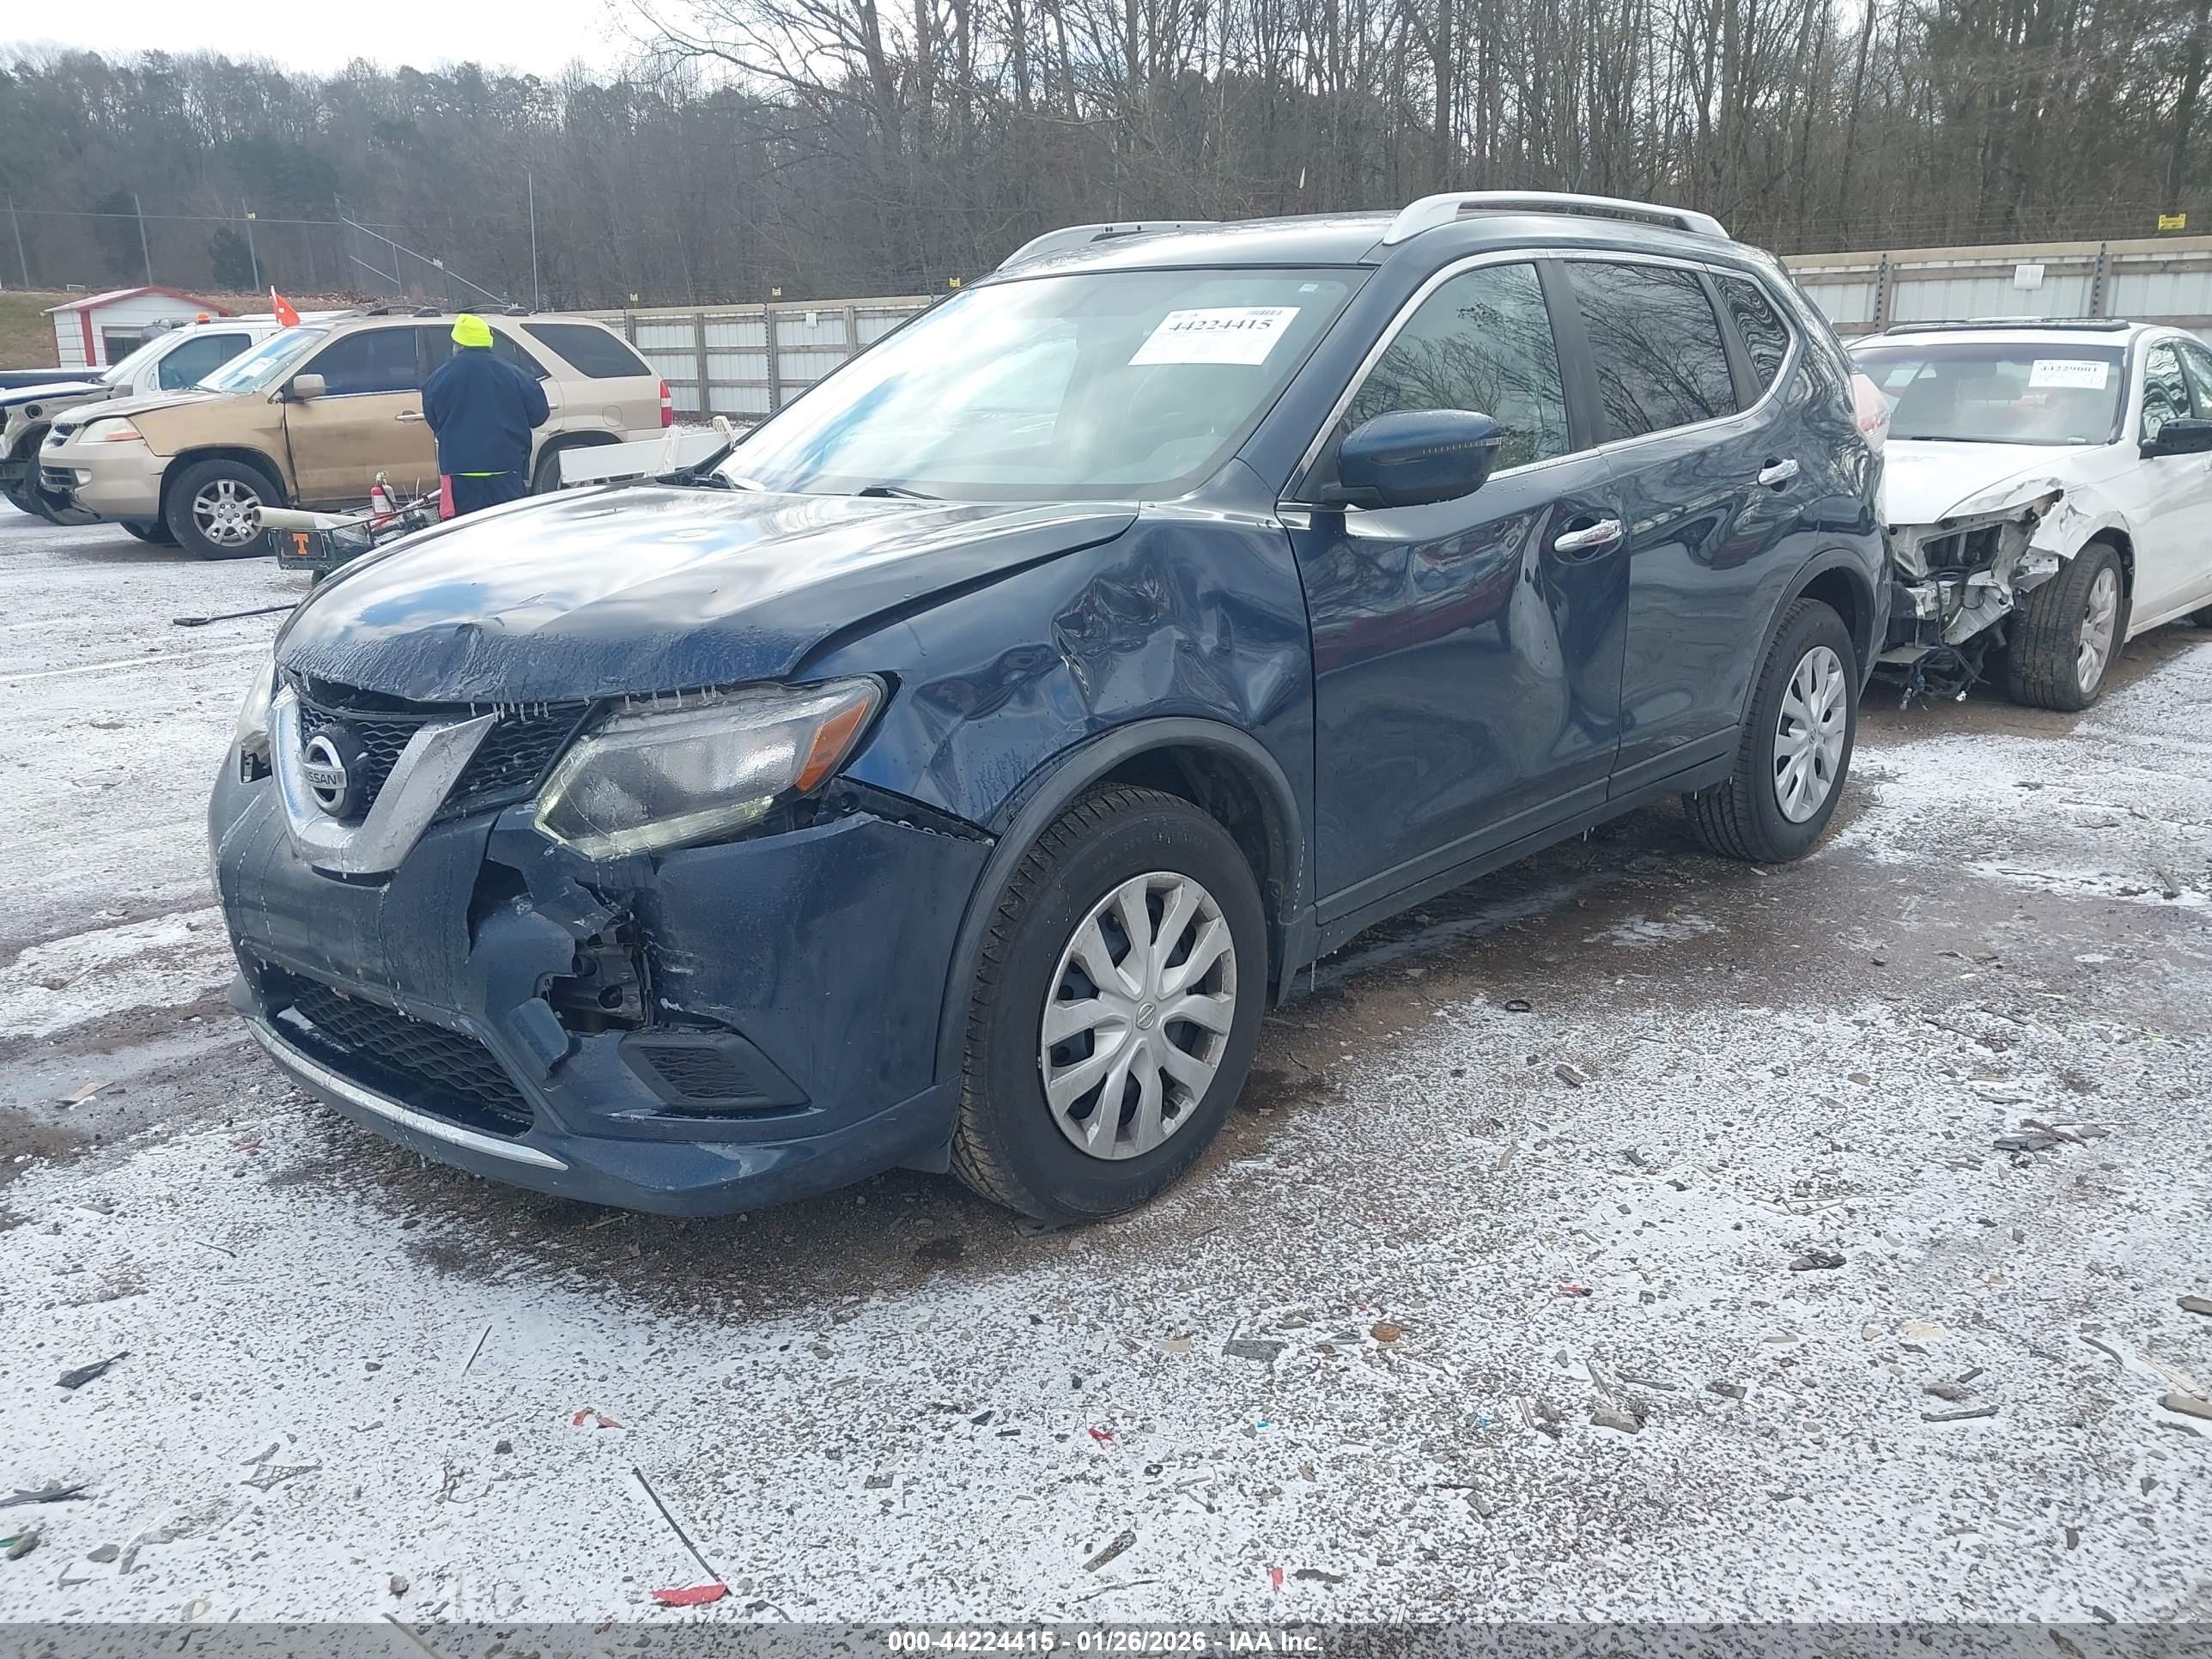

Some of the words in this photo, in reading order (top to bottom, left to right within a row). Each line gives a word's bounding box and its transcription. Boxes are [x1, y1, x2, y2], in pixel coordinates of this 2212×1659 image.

[1169, 319, 1273, 331] 44224415
[293, 533, 309, 555] T
[304, 770, 337, 785] SSAN
